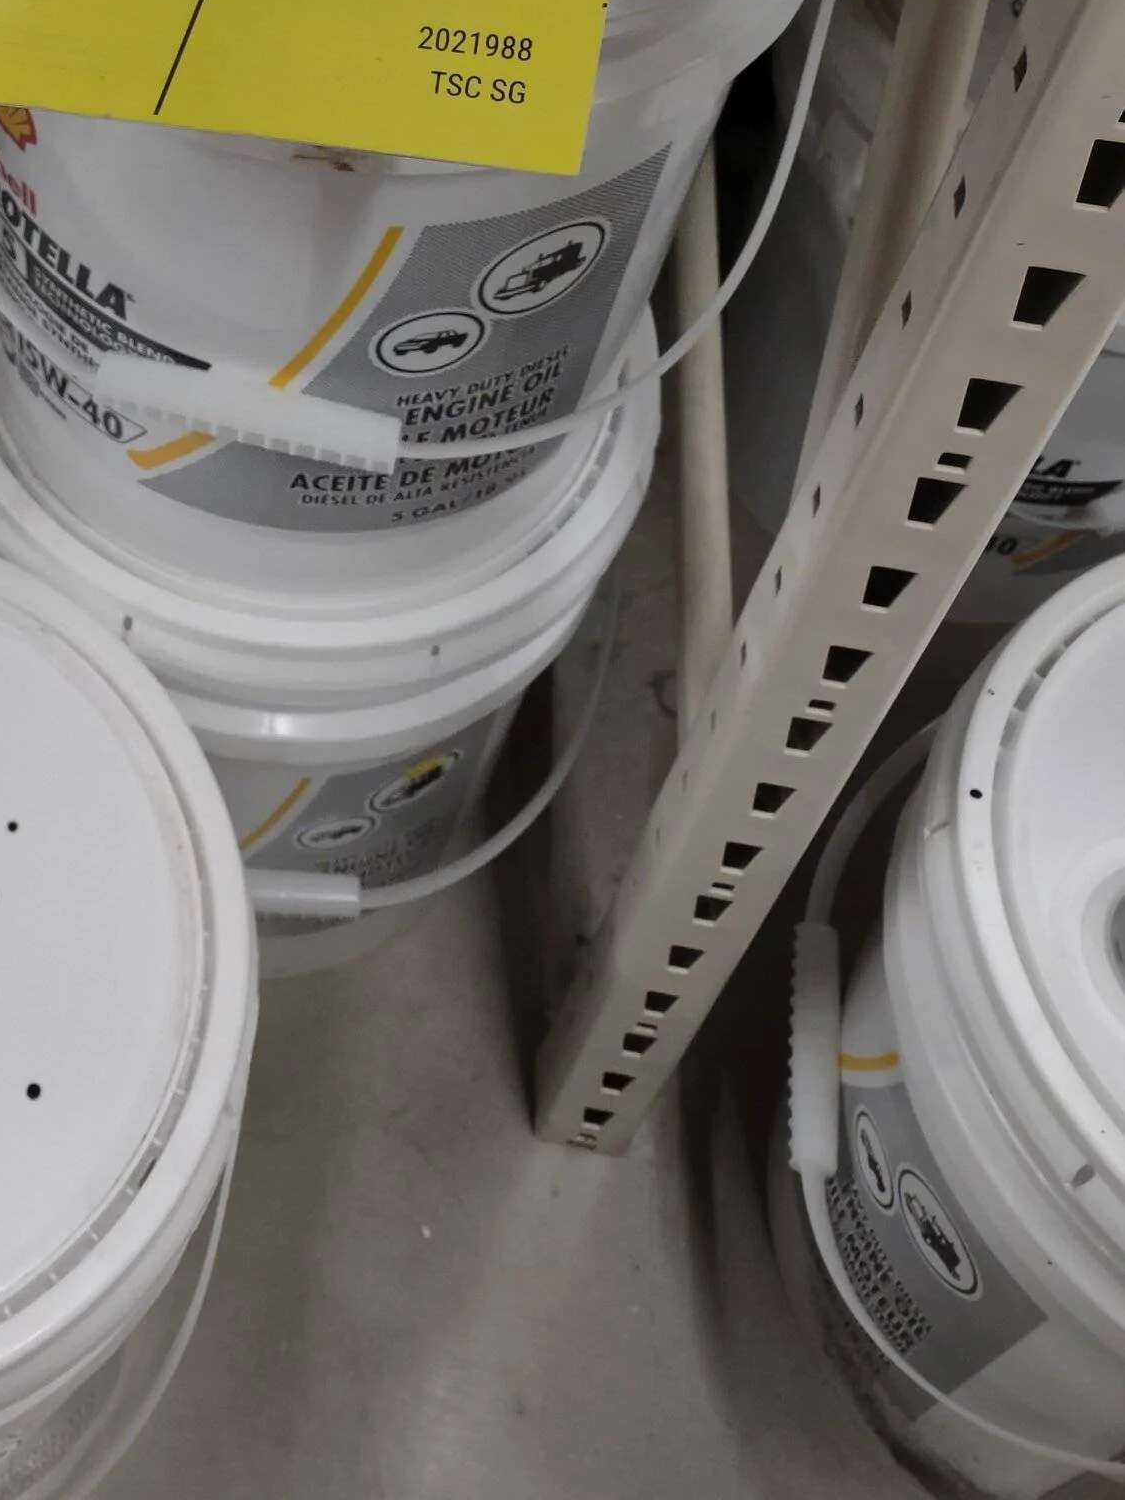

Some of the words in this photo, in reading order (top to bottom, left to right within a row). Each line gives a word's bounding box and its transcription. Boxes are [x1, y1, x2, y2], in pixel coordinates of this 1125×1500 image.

[418, 25, 533, 61] 2021988
[431, 70, 482, 99] TSC
[490, 78, 526, 104] SG
[396, 386, 460, 407] HEAVY
[466, 369, 514, 395] DUTY
[404, 384, 514, 426] ENGINE
[522, 362, 562, 393] OIL
[439, 386, 556, 443] MOTEUR
[289, 473, 389, 493] ACEITE
[399, 465, 436, 489] DE
[392, 485, 433, 502] ALTA
